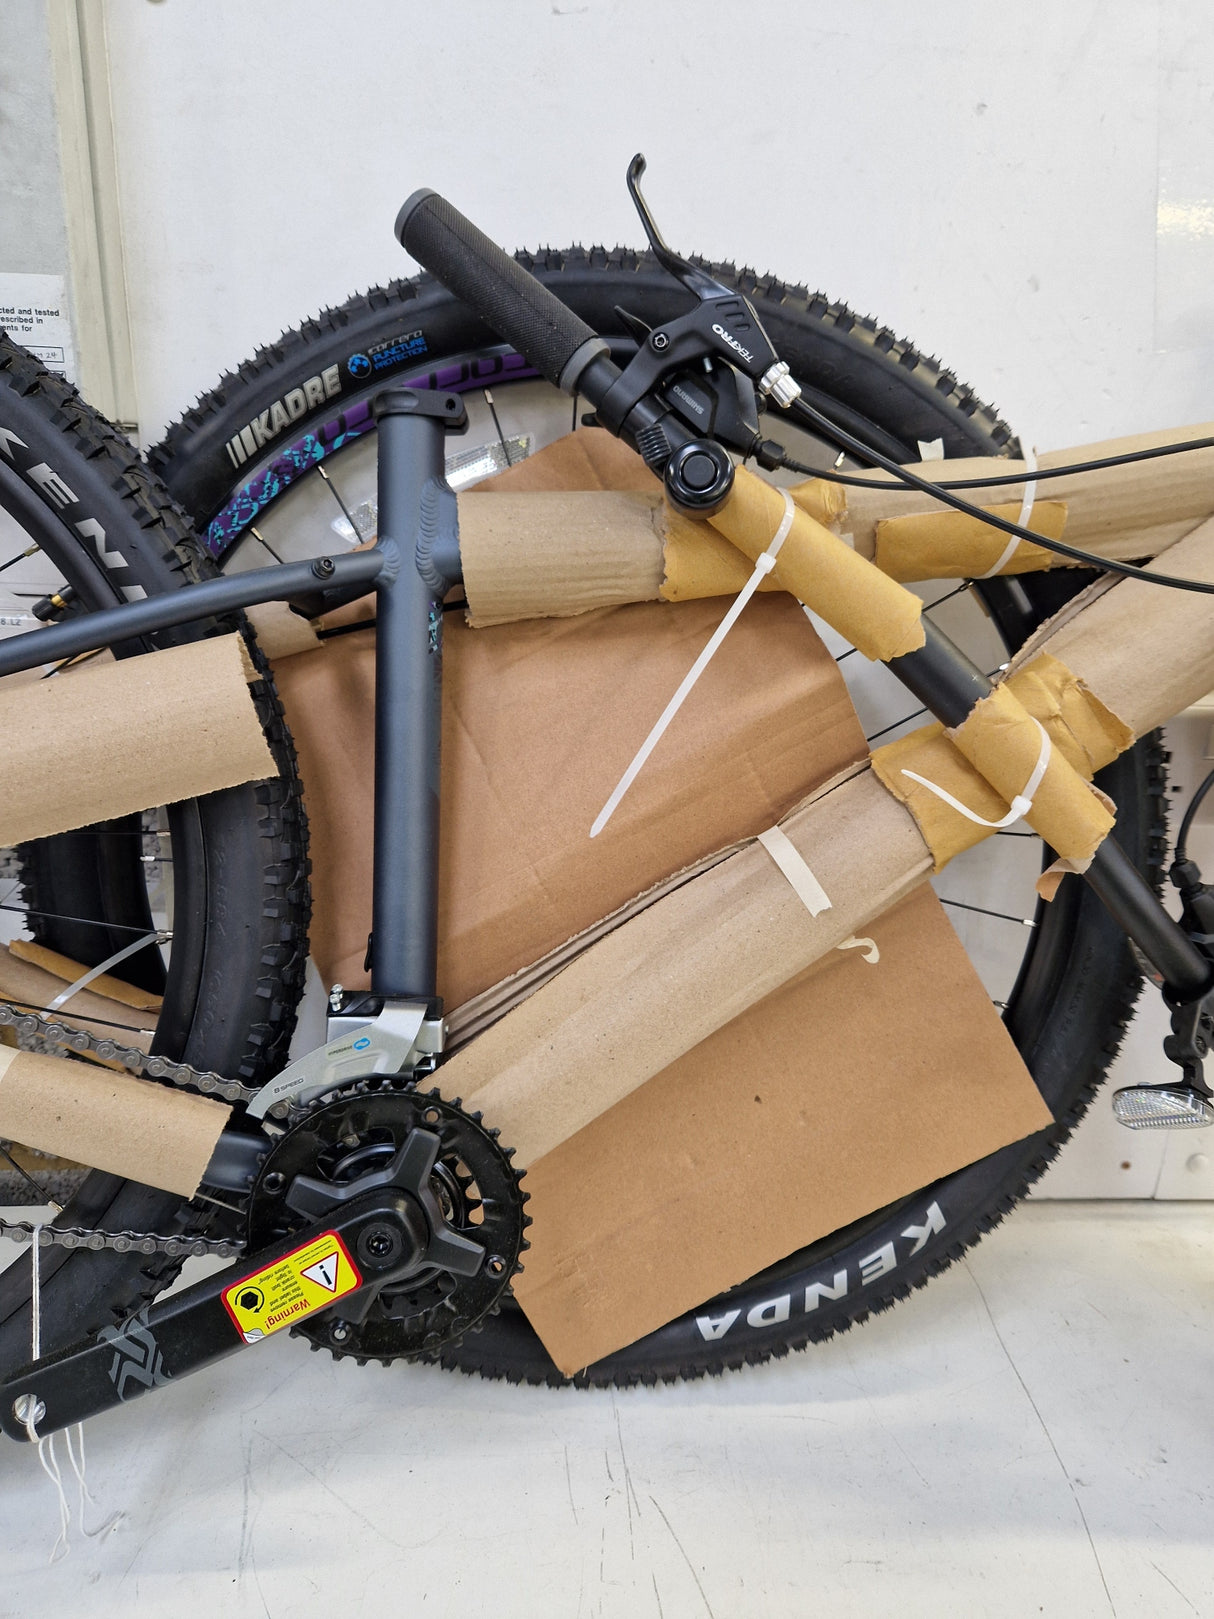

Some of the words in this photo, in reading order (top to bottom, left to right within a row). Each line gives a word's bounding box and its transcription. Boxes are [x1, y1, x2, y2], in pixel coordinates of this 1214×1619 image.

[35, 309, 60, 317] tested
[22, 324, 33, 332] for
[372, 337, 426, 362] PUNCTURE
[712, 323, 754, 364] TEKTRO
[374, 345, 428, 371] PROTECTION
[249, 363, 342, 443] KADRE
[672, 384, 705, 415] SHIMANO
[280, 1078, 304, 1092] SPEED
[696, 1200, 947, 1342] KENDA
[263, 1298, 311, 1330] Warning!
